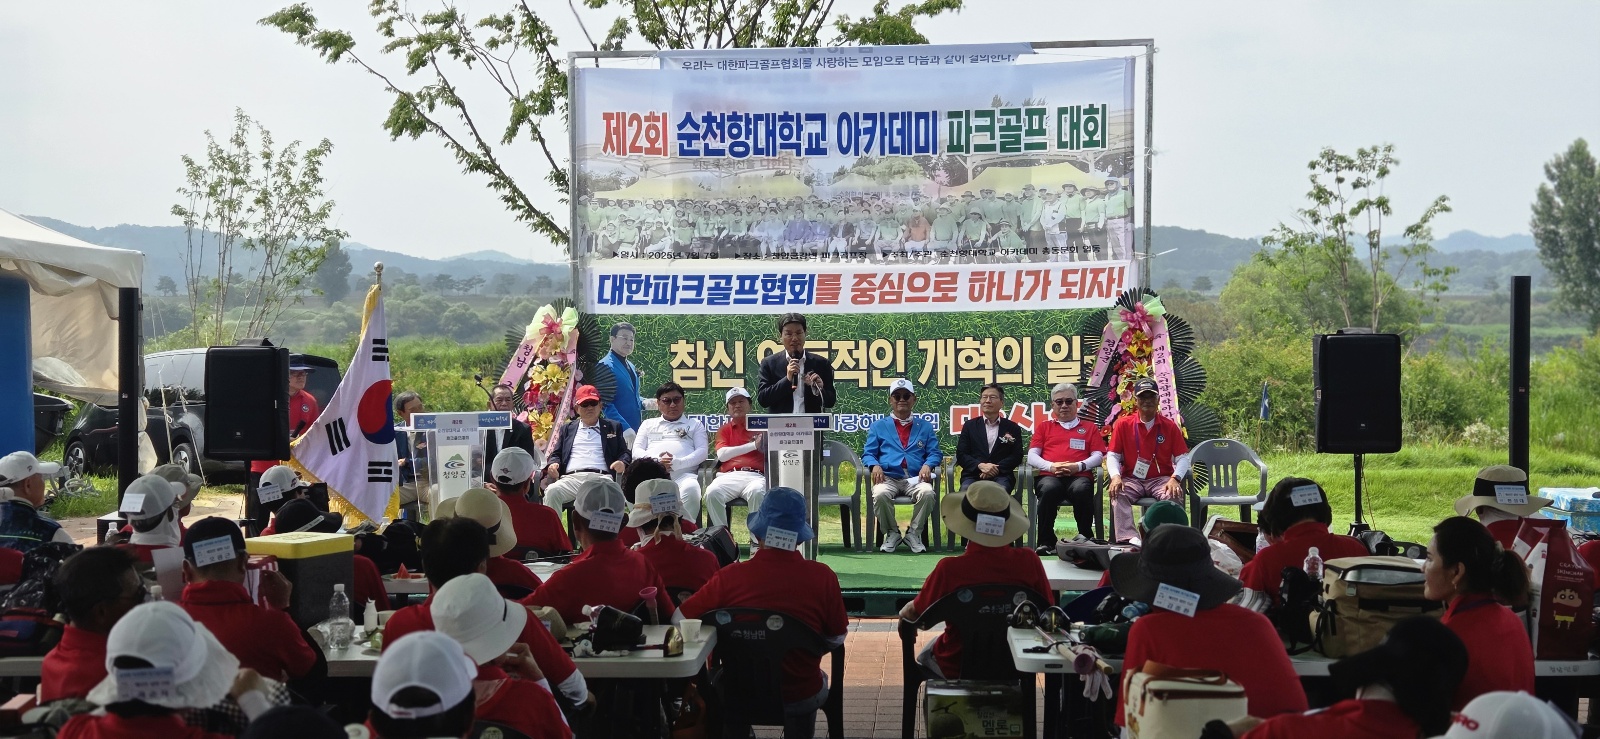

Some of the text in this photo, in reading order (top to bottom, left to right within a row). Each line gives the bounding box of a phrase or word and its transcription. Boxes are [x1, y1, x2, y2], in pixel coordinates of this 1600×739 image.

[681, 60, 714, 71] 우리는
[718, 57, 812, 71] 대한파크골프협회를
[816, 56, 859, 69] 사랑하는
[862, 55, 905, 67] 모임으로
[908, 55, 940, 66] 다음과
[602, 103, 1107, 158] 제2회 순천향대학교 아카데미 파크골프 대회
[648, 251, 681, 259] 2025년
[940, 249, 996, 258] 순천향대학교
[1000, 247, 1038, 256] 아카데미
[1042, 245, 1079, 255] 총동문회
[597, 265, 1125, 306] 대한파크골프협회를 중심으로 하나가 되자!
[669, 334, 1095, 389] 참신 적인 개혁의 일
[443, 470, 466, 479] 청양군
[982, 720, 1009, 735] 멜론
